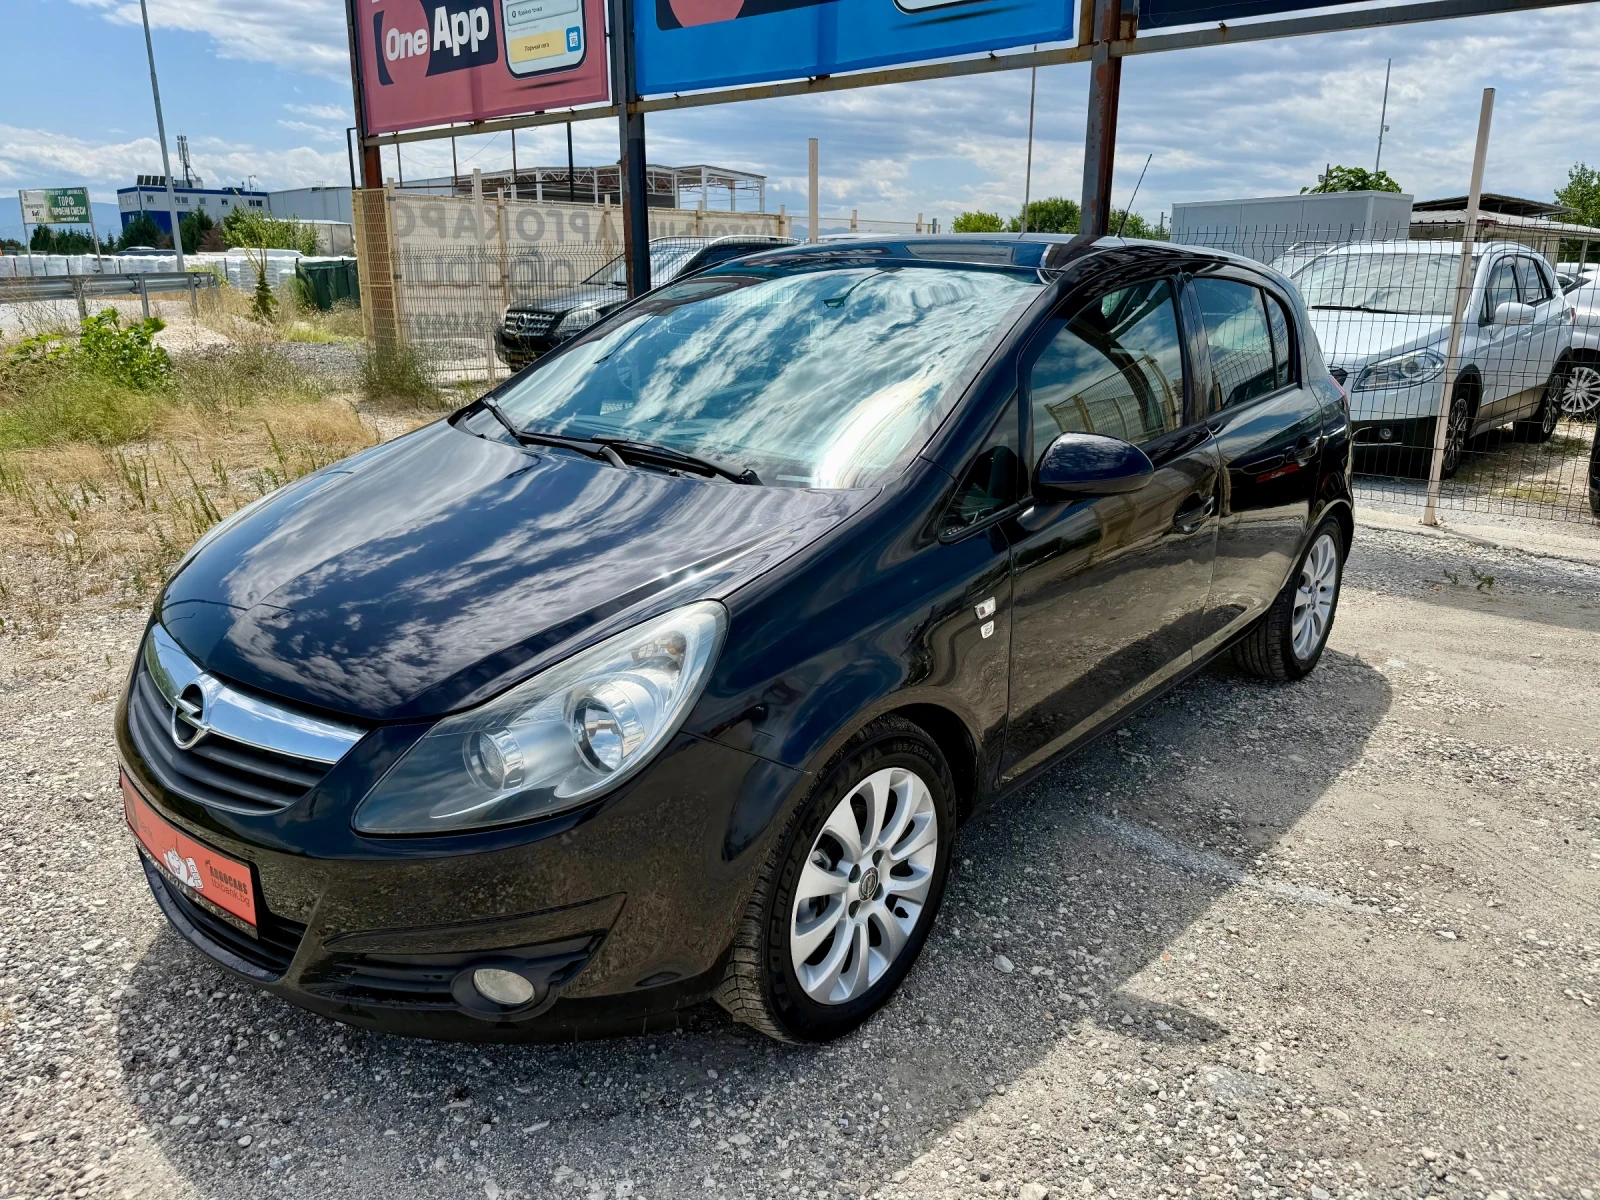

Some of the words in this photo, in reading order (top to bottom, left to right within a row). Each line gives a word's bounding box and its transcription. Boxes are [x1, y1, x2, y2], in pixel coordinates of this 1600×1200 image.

[385, 26, 428, 62] One
[433, 5, 490, 57] App
[58, 196, 75, 206] ТОРФ
[209, 865, 248, 895] ARGOCARS
[211, 877, 251, 907] tbibank.bg
